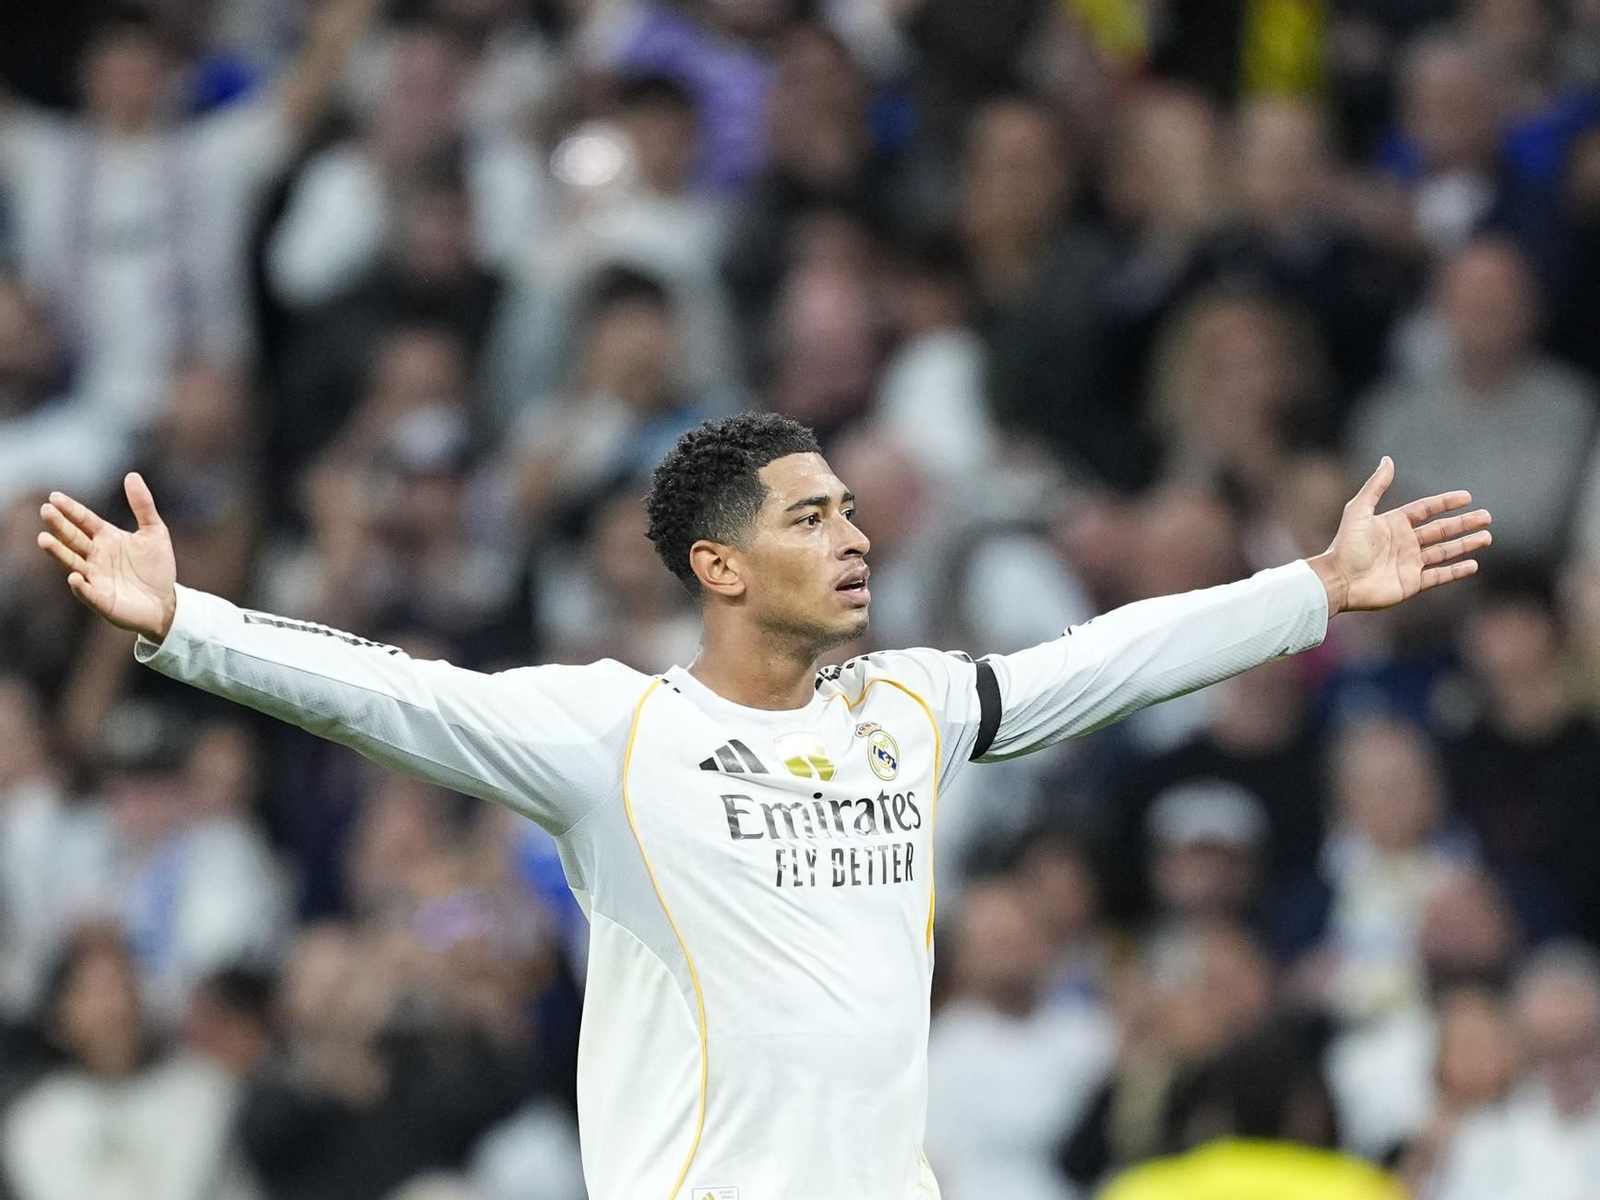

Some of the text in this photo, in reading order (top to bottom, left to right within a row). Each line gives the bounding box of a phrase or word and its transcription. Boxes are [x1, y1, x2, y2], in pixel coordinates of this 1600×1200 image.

[720, 787, 922, 841] Emirates
[775, 842, 914, 888] FLY BETTER
